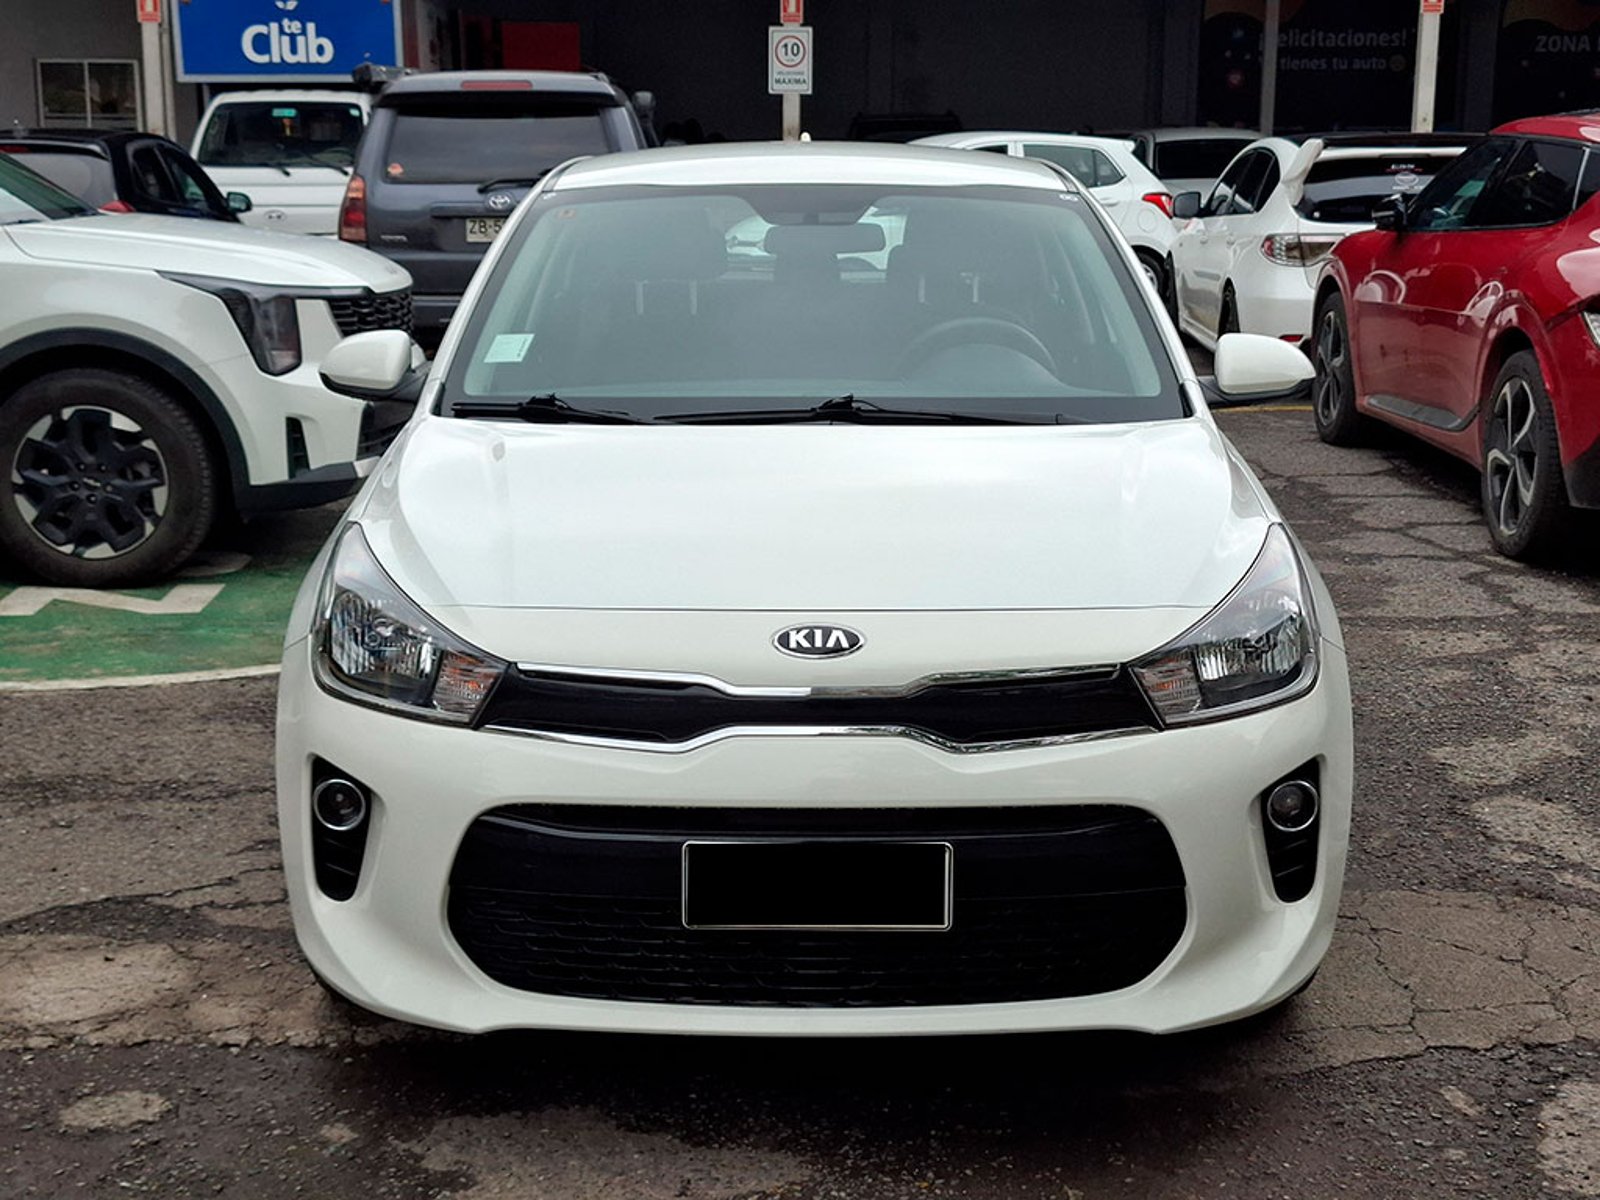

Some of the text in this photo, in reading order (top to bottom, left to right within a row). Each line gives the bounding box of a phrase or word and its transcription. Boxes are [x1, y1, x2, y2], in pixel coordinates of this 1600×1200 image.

[281, 17, 302, 34] te
[241, 22, 334, 64] Club
[781, 42, 800, 57] 10
[1534, 34, 1592, 53] ZONA
[1279, 55, 1328, 71] tienes
[1332, 56, 1349, 71] tu
[1352, 57, 1388, 71] auto
[788, 628, 850, 649] KIA
